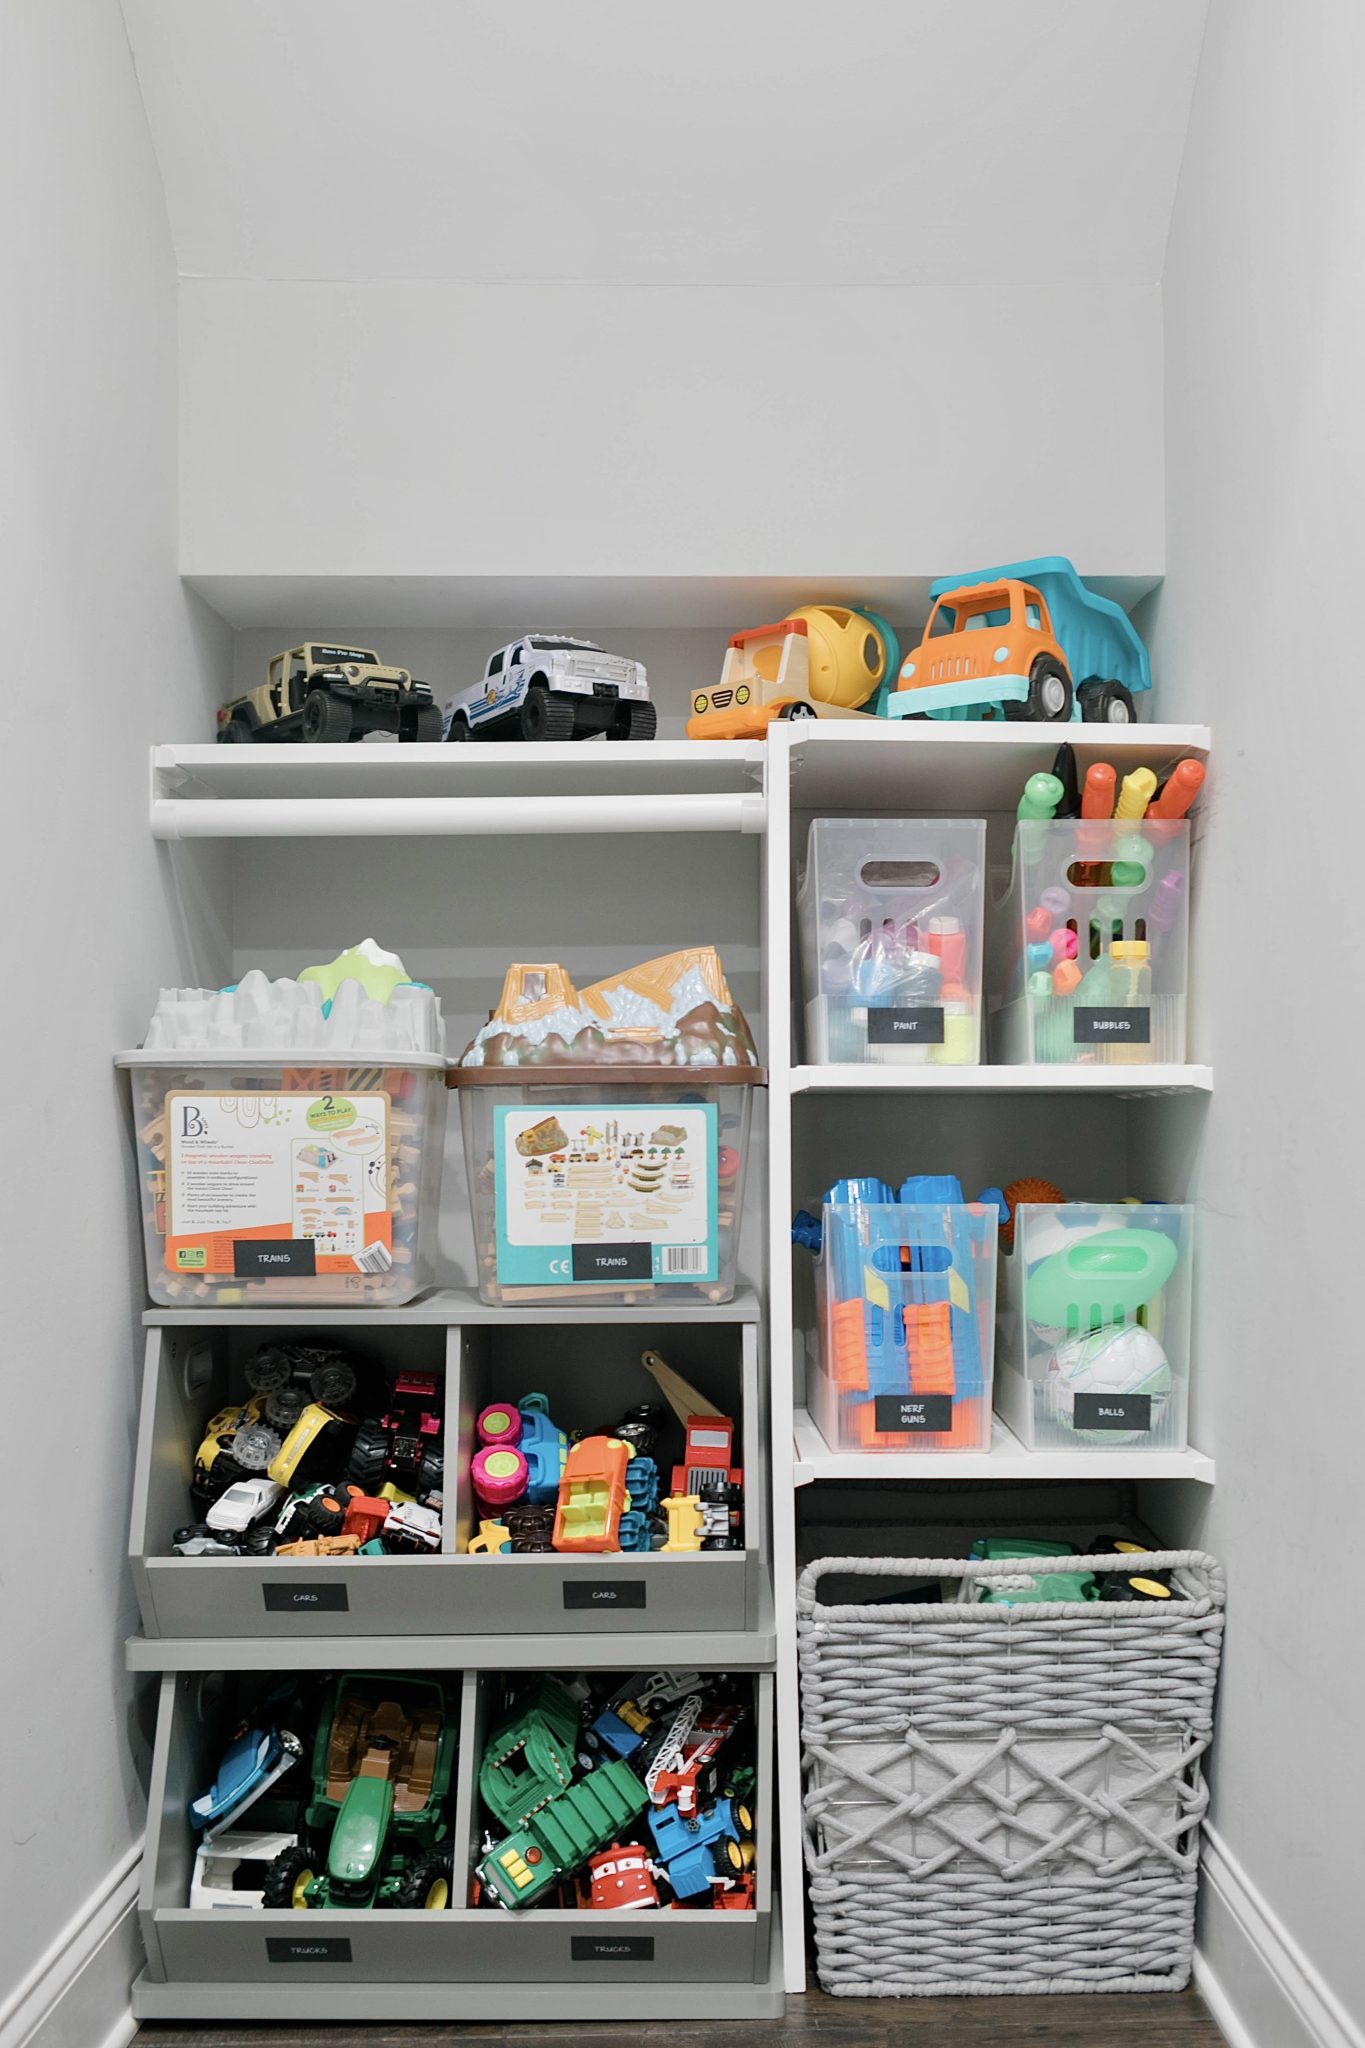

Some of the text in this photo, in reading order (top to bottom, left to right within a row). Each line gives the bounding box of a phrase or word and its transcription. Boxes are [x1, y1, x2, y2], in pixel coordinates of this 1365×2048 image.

[893, 1021, 918, 1030] PAINT
[1092, 1021, 1131, 1030] BUBBLES
[322, 1095, 335, 1110] 2
[310, 1110, 327, 1118] WAYS
[257, 1254, 291, 1263] TRAINS
[595, 1257, 628, 1267] TRAINS
[900, 1404, 925, 1413] NERF
[1098, 1407, 1125, 1417] BALLS
[901, 1415, 926, 1424] GUNS
[293, 1594, 318, 1602] CARS
[592, 1591, 617, 1599] CARS
[594, 1945, 632, 1953] TRUCKS
